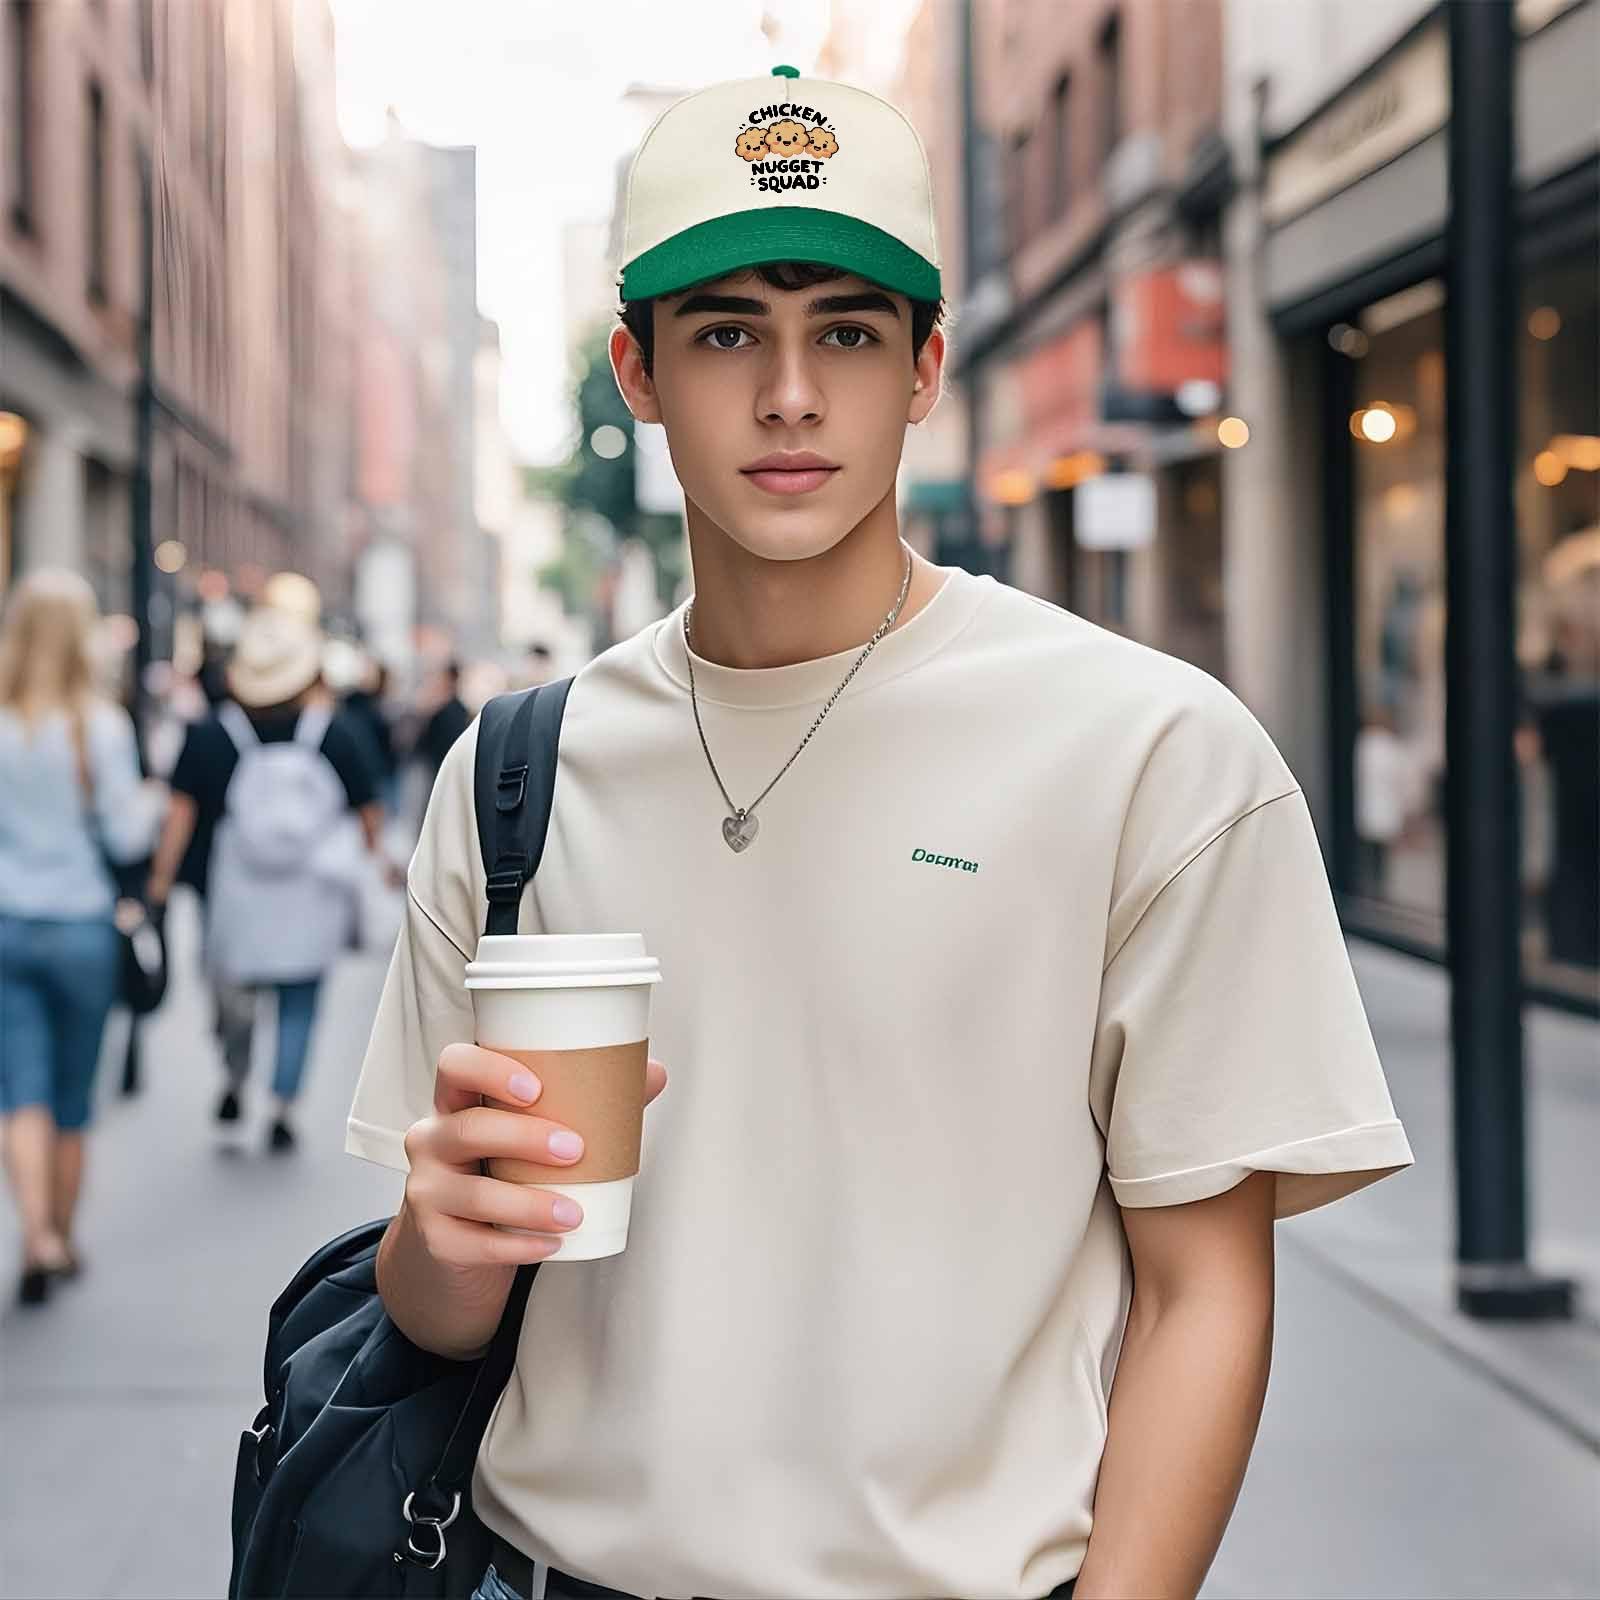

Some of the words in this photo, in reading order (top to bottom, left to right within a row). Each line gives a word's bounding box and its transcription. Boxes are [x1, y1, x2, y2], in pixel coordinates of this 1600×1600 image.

[749, 104, 827, 126] CHICKEN
[752, 160, 824, 175] NUGGET
[758, 175, 820, 193] SQUAD
